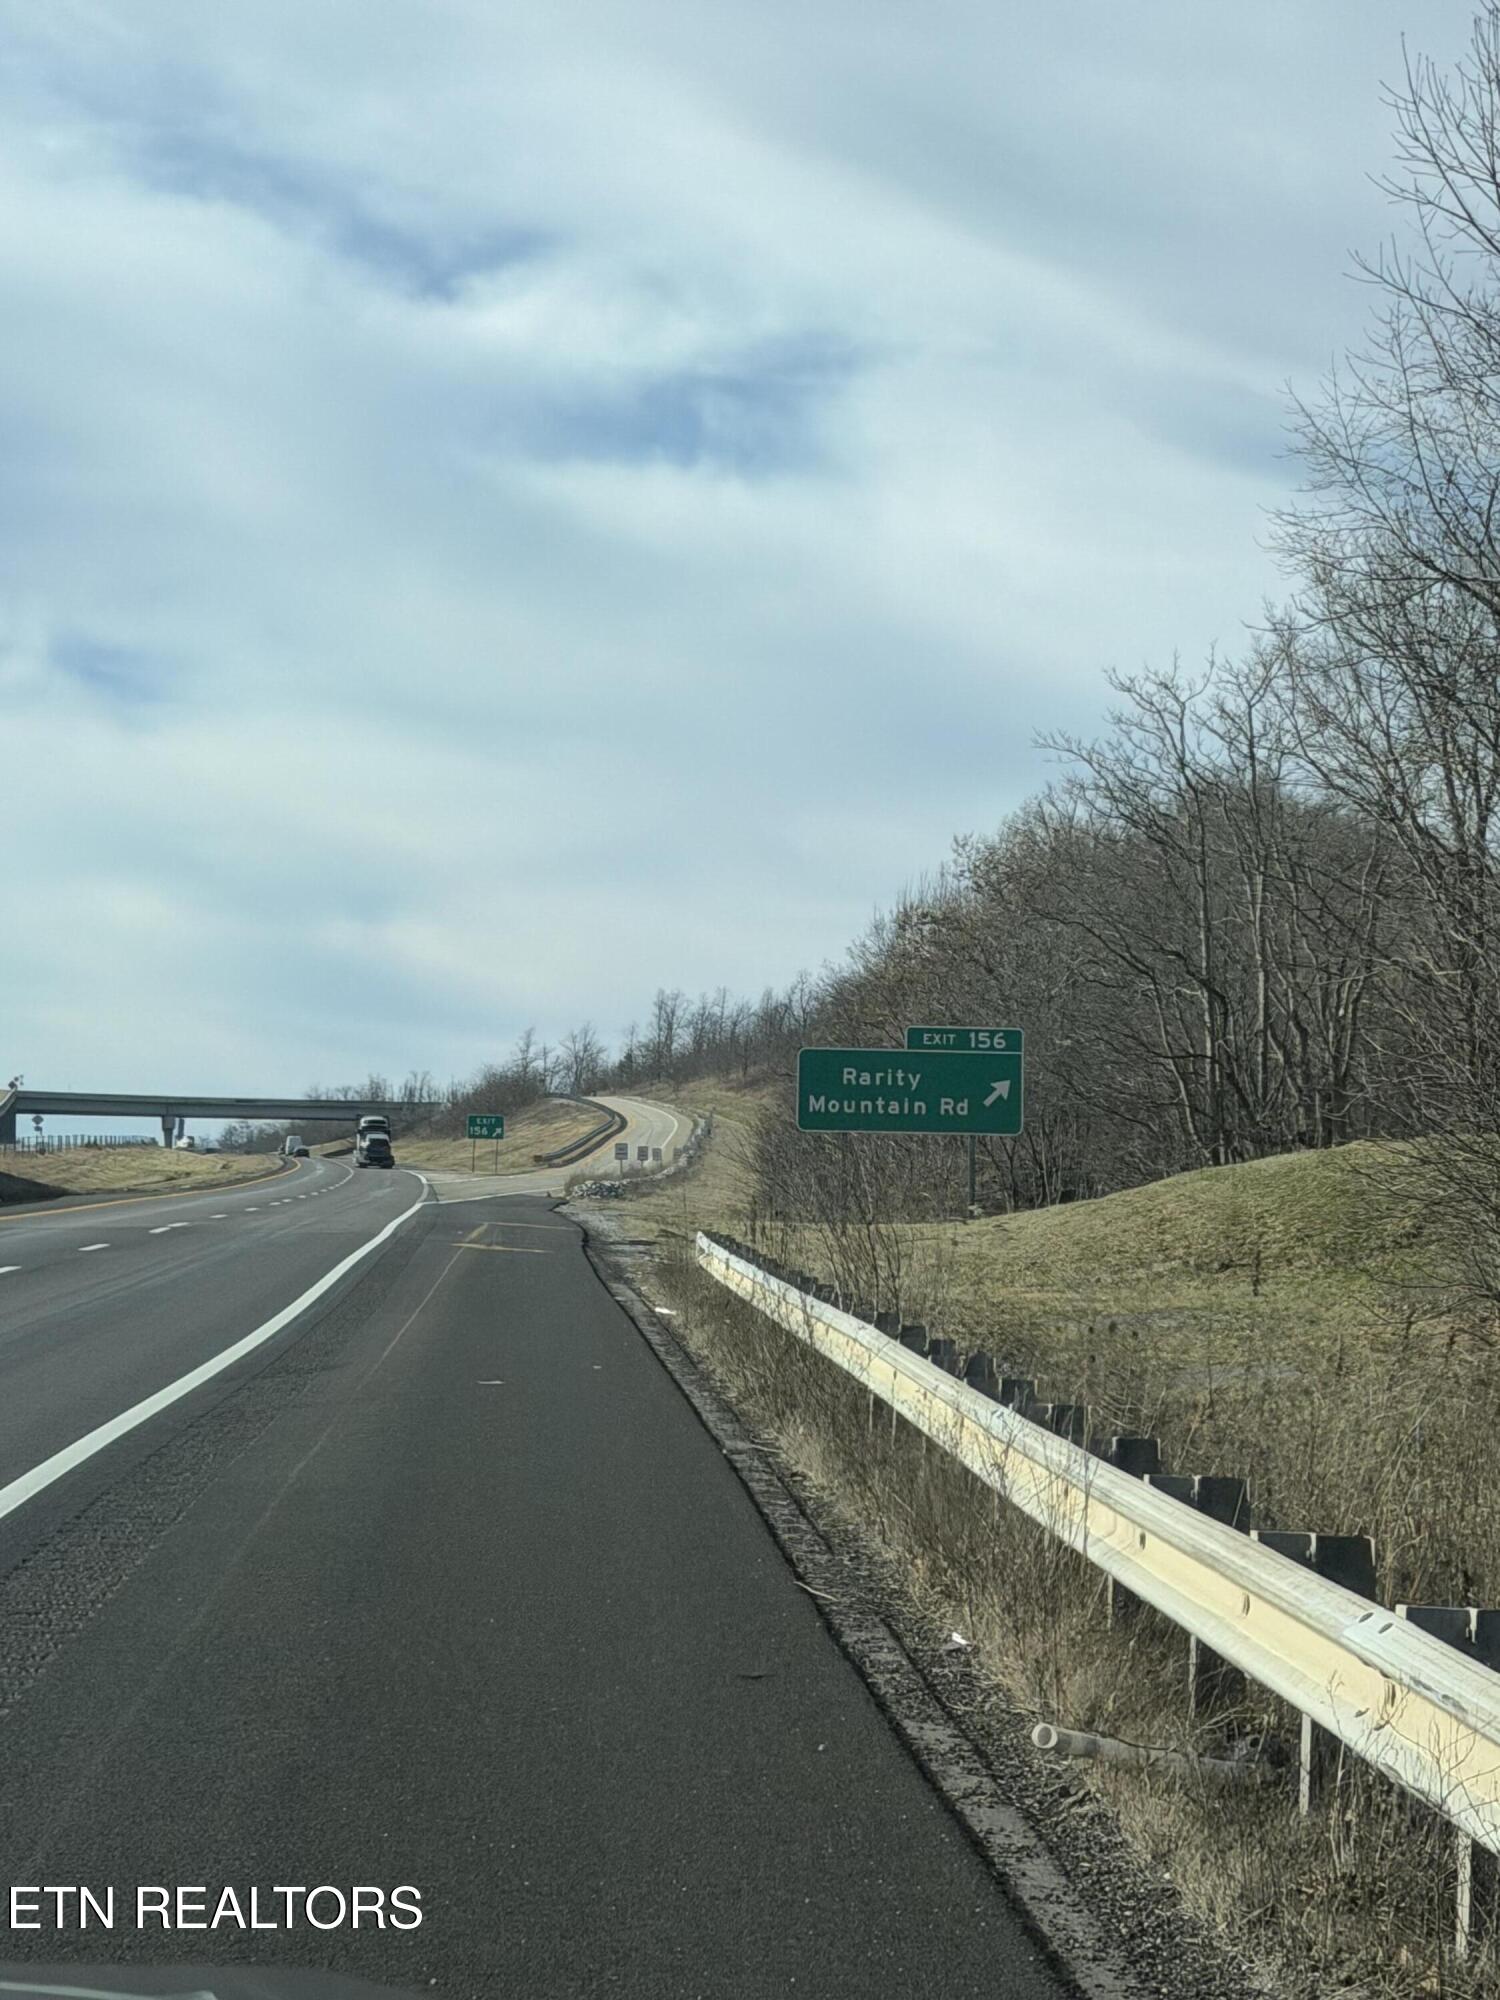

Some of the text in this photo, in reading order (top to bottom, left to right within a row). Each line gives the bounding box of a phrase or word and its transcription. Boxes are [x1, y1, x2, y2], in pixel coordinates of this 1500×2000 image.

[923, 1032, 1006, 1049] EXIT 156
[843, 1068, 921, 1090] Rarity
[809, 1095, 969, 1116] Mountain Rd
[476, 1117, 496, 1125] EXIT
[469, 1126, 488, 1136] 156
